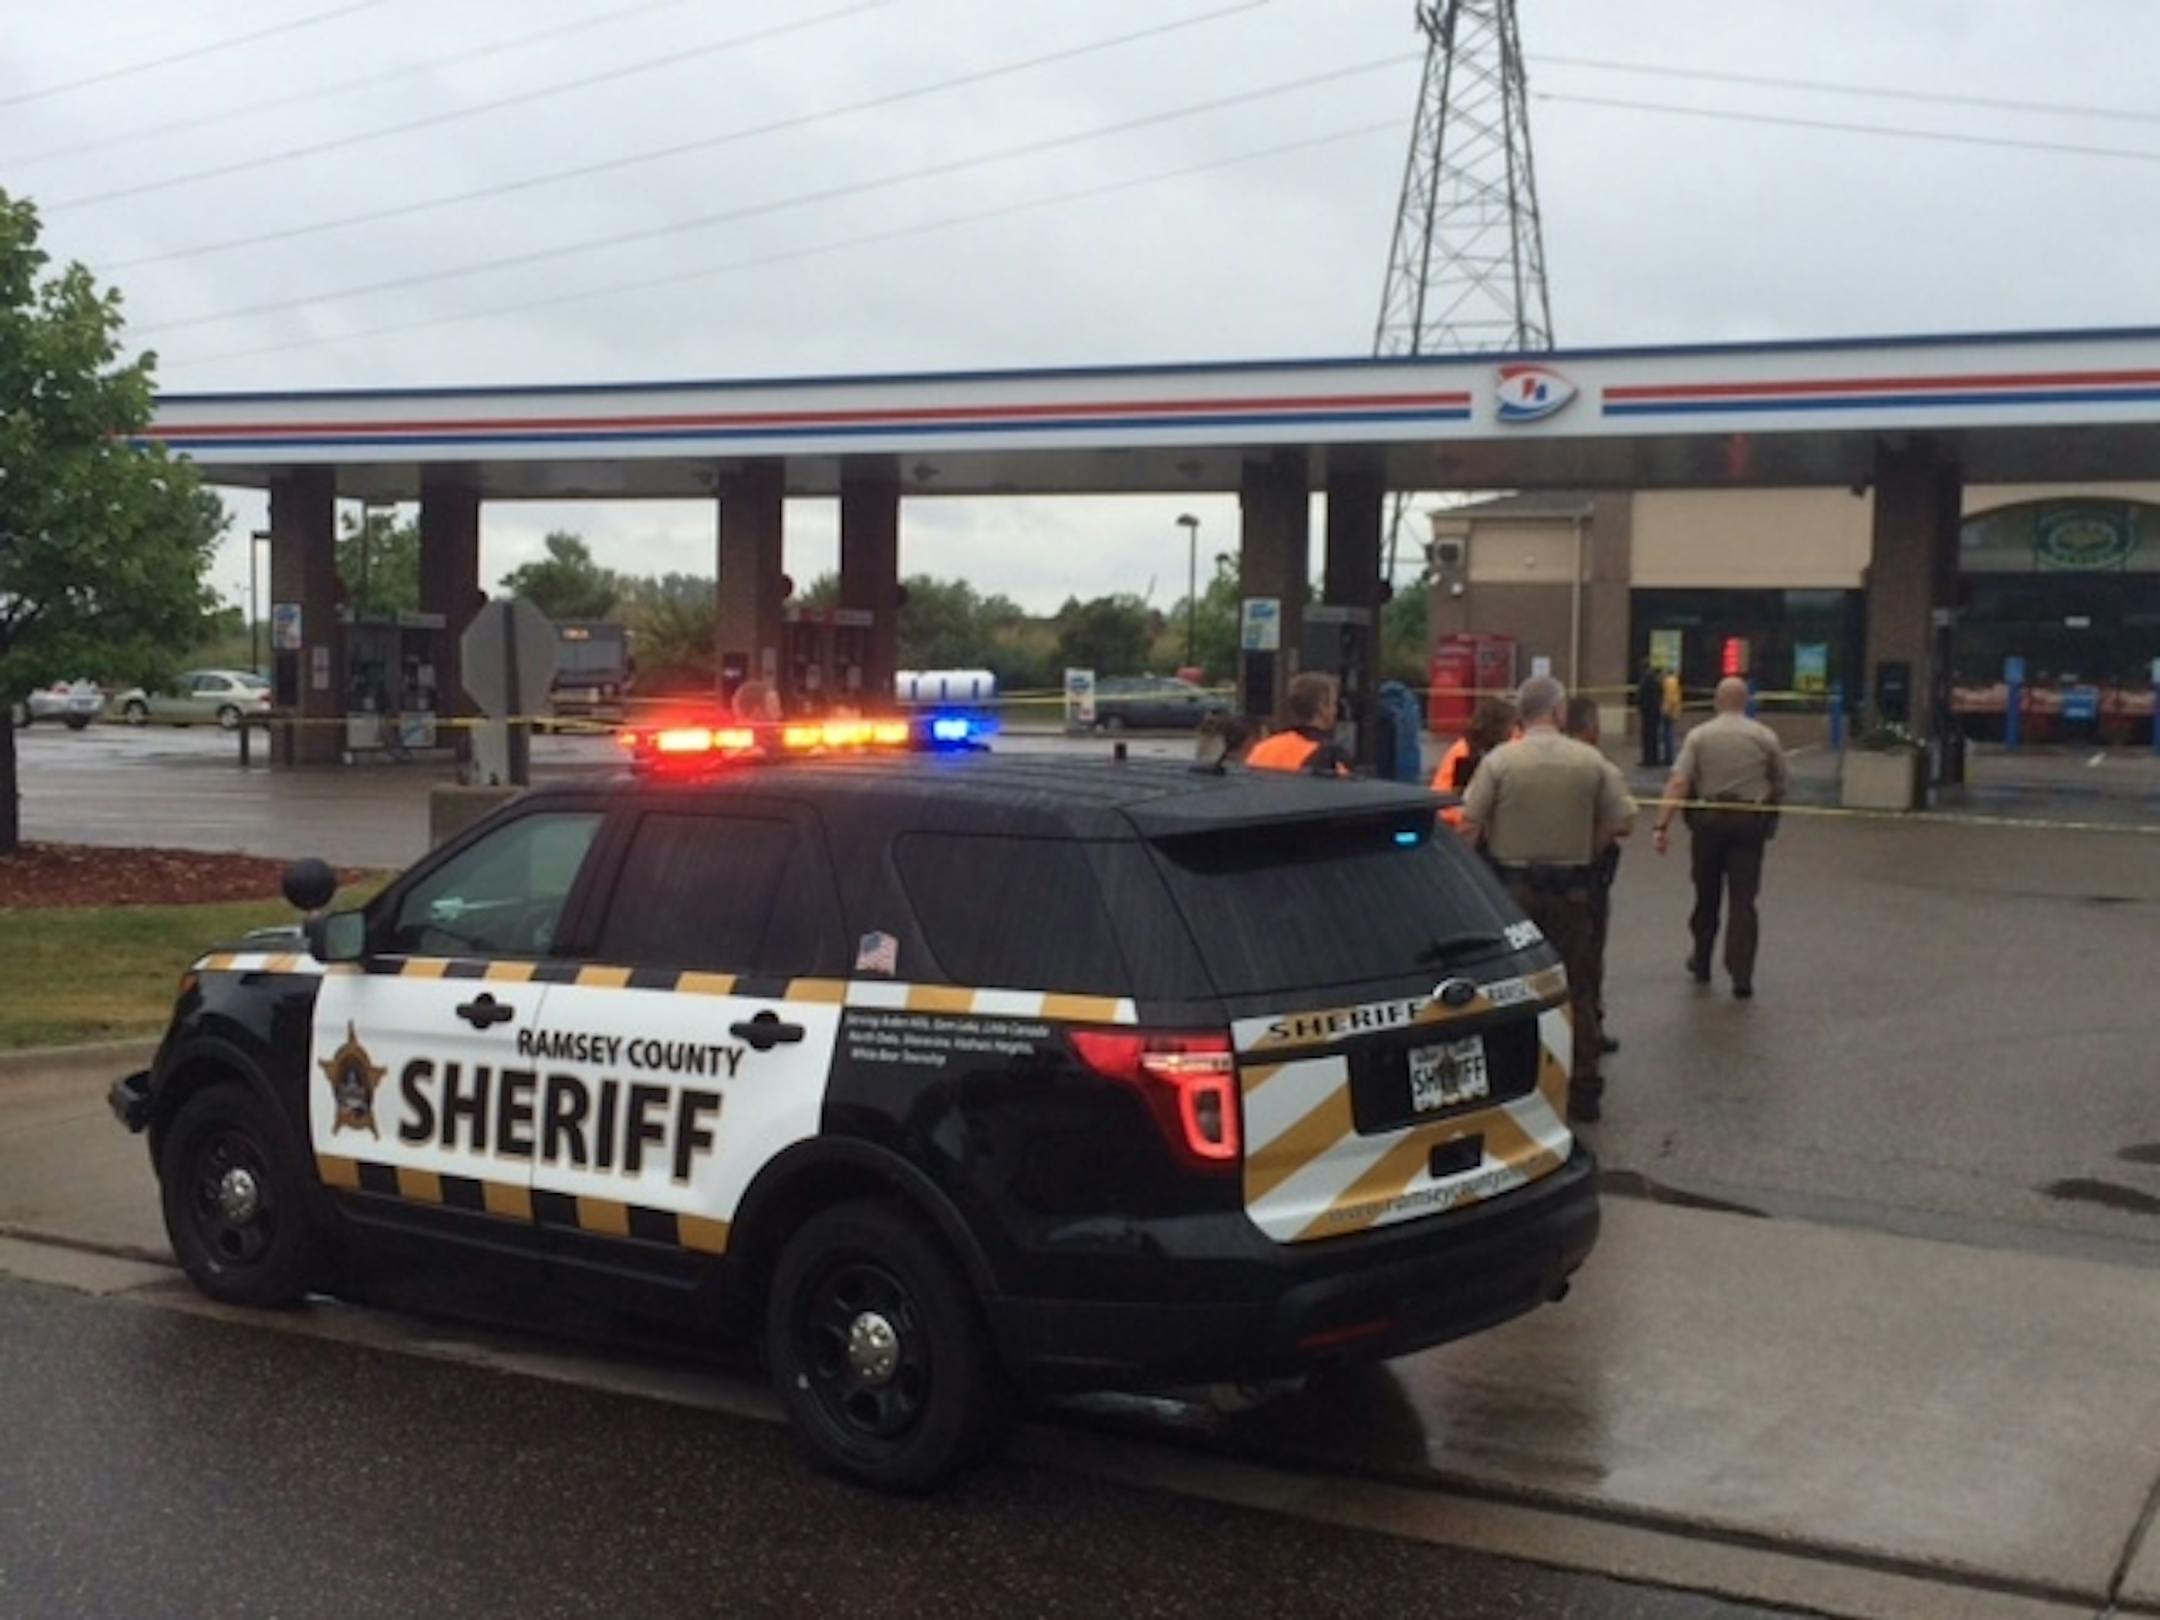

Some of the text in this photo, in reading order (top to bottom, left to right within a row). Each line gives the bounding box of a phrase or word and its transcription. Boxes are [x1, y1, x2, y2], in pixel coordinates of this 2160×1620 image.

[1267, 1001, 1422, 1040] SHERIFF
[517, 1028, 745, 1078] RAMSEY COUNTY
[399, 1056, 725, 1187] SHERIFF
